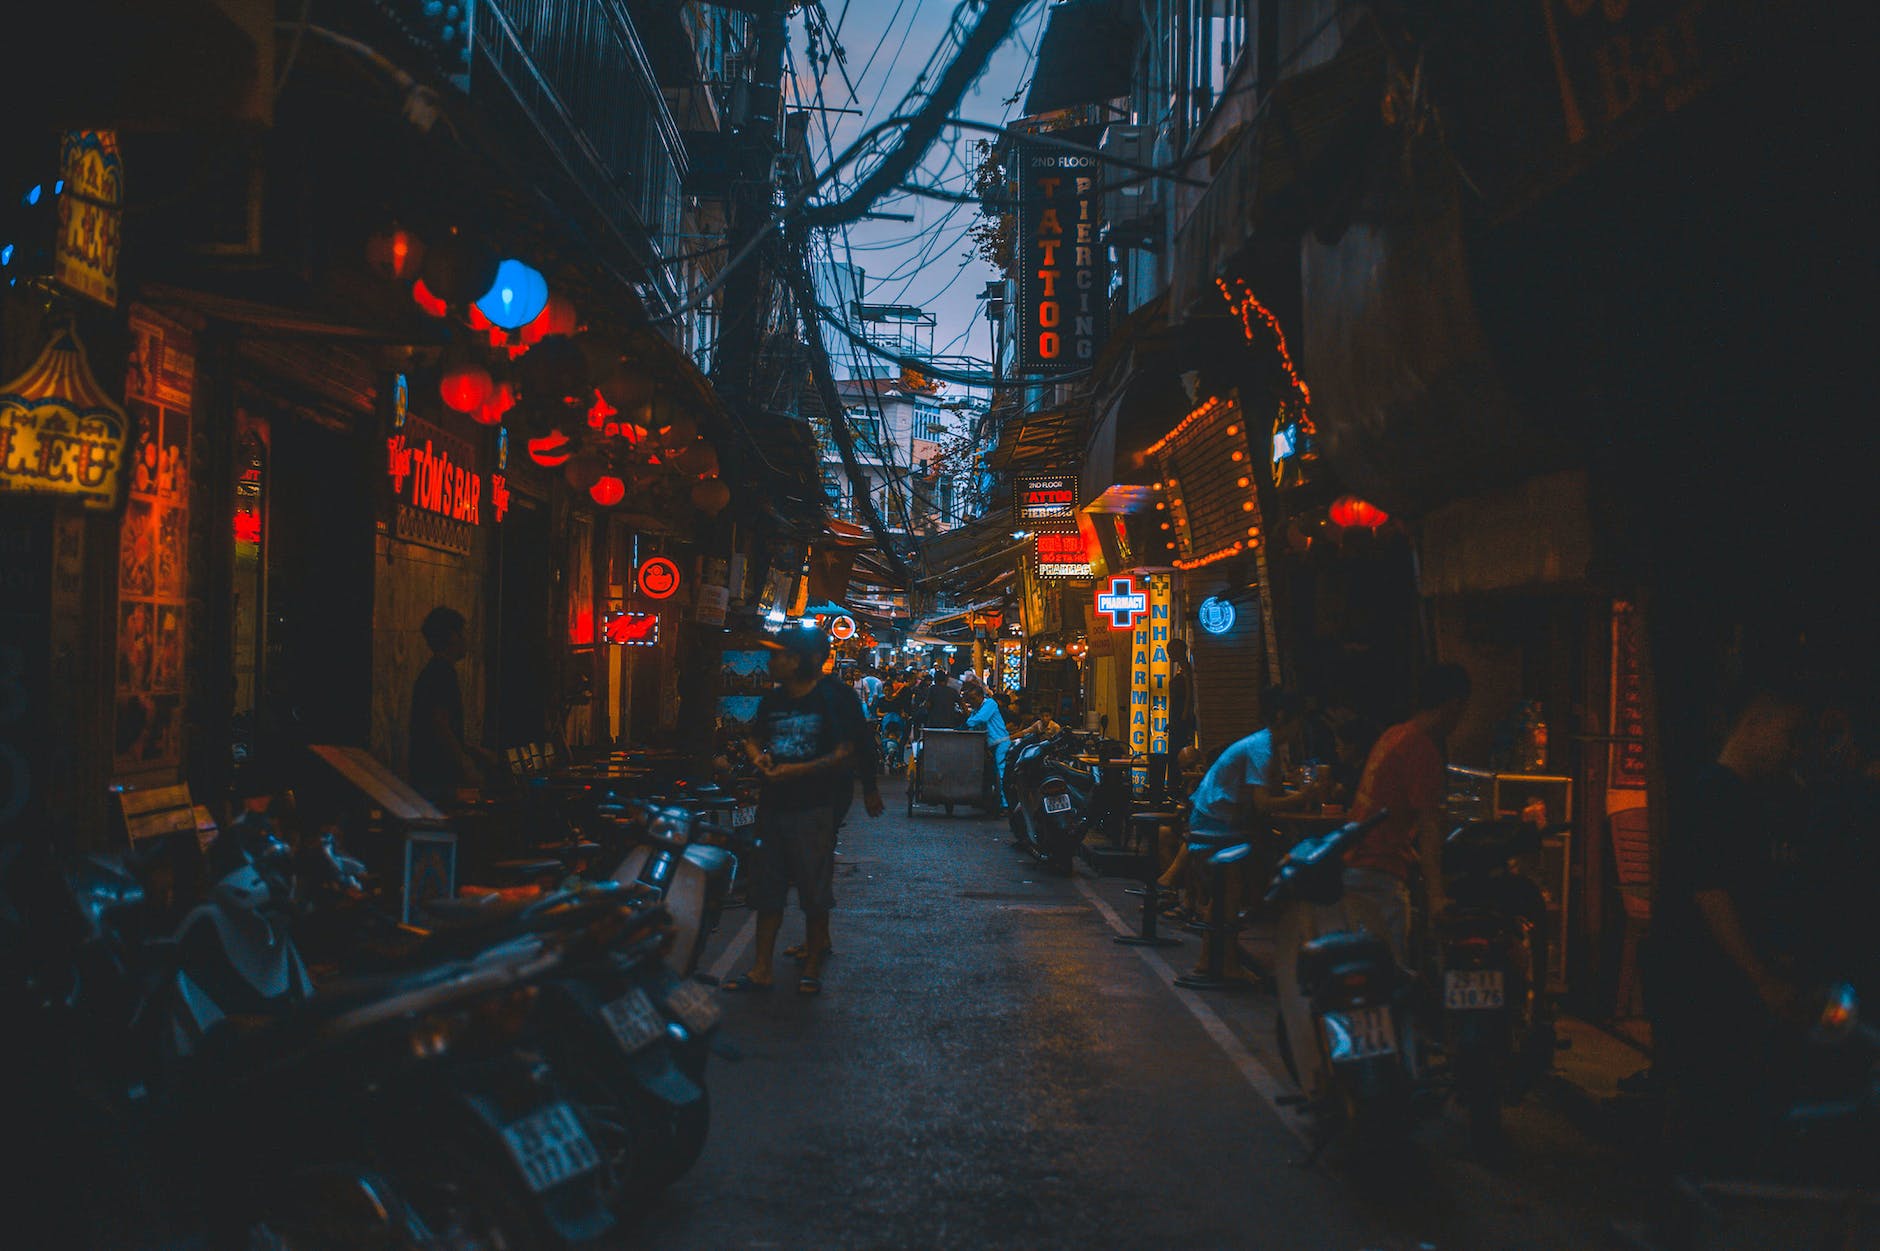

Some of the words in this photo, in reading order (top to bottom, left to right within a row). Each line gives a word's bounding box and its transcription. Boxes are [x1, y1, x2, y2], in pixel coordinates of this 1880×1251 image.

[1031, 157, 1055, 168] 2ND
[1058, 156, 1096, 168] FLOOR
[1037, 177, 1062, 359] TATTOO
[1075, 177, 1094, 359] PIERCING
[453, 466, 481, 526] BAR
[1021, 491, 1073, 503] TATTOO
[1042, 481, 1063, 489] FLOOR
[1101, 596, 1143, 610] PHARMACY
[1152, 604, 1168, 663] NHÀ
